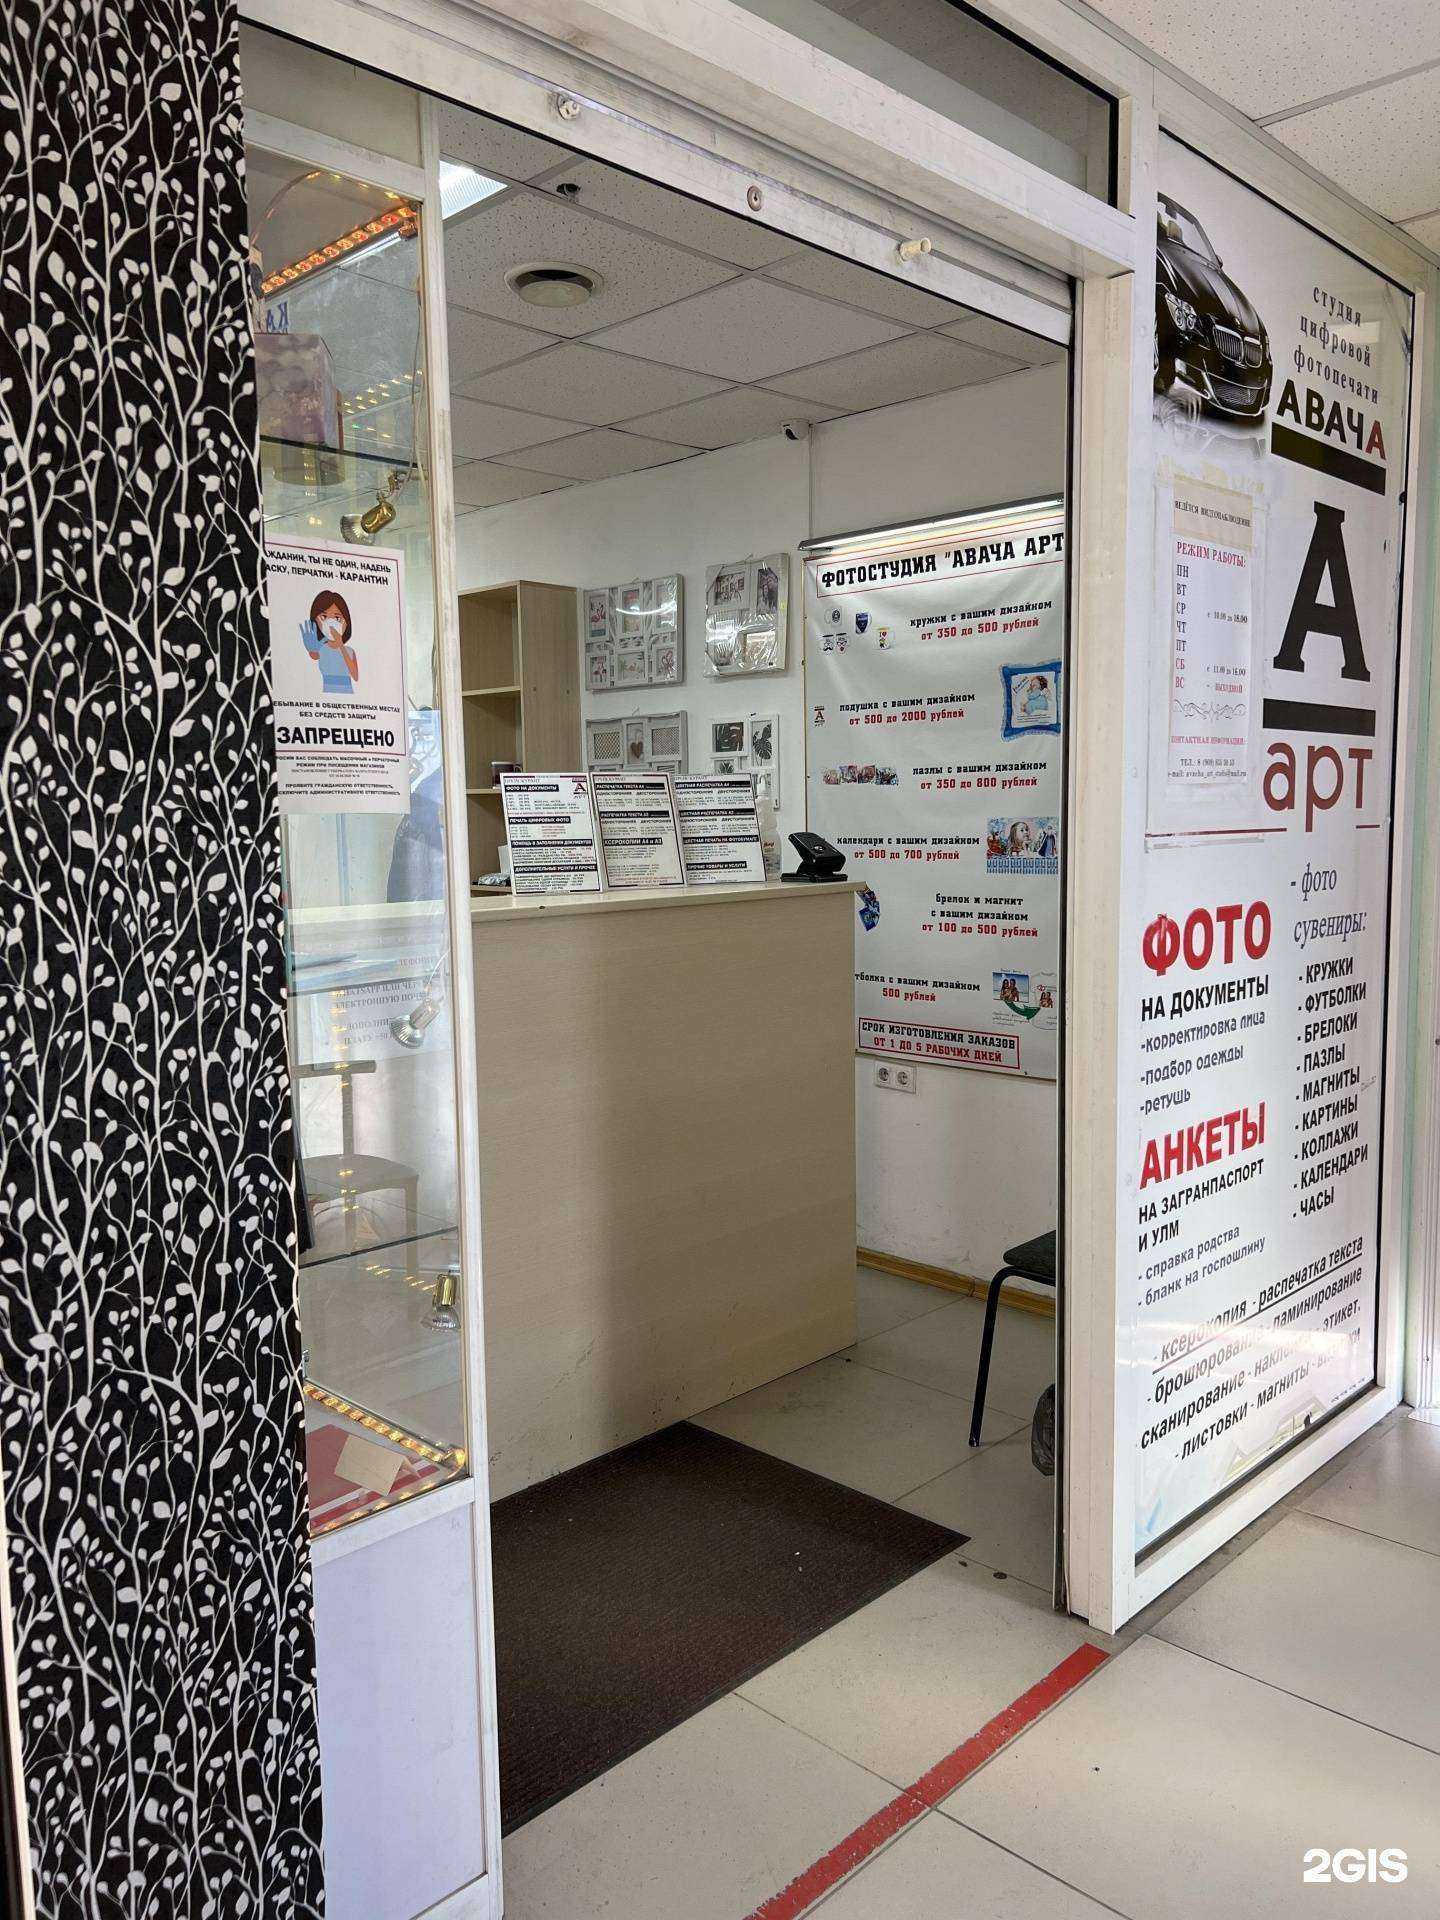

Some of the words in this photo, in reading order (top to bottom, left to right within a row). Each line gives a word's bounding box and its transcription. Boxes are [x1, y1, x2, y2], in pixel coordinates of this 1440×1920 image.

[1313, 286, 1362, 327] студия
[1300, 316, 1370, 368] цифровой
[1294, 345, 1378, 404] фотопечати
[1276, 379, 1386, 460] АВАЧА
[266, 550, 306, 563] ЖДАНИН,
[308, 556, 320, 564] ТЫ
[335, 559, 358, 569] ОДИН,
[361, 563, 391, 572] НАДЕНЬ
[821, 553, 937, 588] ФОТОСТУДИЯ
[945, 541, 1015, 569] "АВАЧА
[1024, 532, 1064, 557] АРТ
[1177, 542, 1210, 559] РЕЖИМ
[1212, 549, 1246, 568] РАБОТЫ:
[266, 564, 290, 574] АСКУ,
[292, 567, 334, 579] ПЕРЧАТКИ
[340, 572, 389, 585] КАРАНТИН
[1177, 564, 1188, 577] ПН
[1177, 583, 1187, 596] ВТ
[1273, 501, 1370, 682] А
[910, 613, 947, 628] кружки
[951, 613, 956, 622] с
[961, 608, 995, 621] вашим
[1000, 600, 1052, 616] дизайном
[1177, 602, 1185, 614] СР
[921, 631, 933, 641] от
[937, 626, 957, 639] 350
[961, 627, 973, 637] до
[977, 621, 998, 634] 500
[1002, 618, 1039, 634] рублей
[1177, 621, 1186, 633] ЧТ
[1176, 639, 1186, 651] ПТ
[1176, 658, 1185, 669] СБ
[1176, 677, 1184, 688] ВС
[322, 703, 377, 711] ОБЩЕСТВЕННЫХ
[839, 701, 879, 714] подушка
[882, 701, 888, 709] с
[892, 697, 923, 708] вашим
[927, 693, 976, 706] дизайном
[849, 716, 860, 726] от
[864, 712, 883, 724] 500
[886, 715, 897, 723] до
[901, 711, 926, 722] 2000
[931, 708, 964, 721] рублей
[277, 727, 394, 748] ЗАПРЕЩЕНО
[912, 766, 943, 776] пазлы
[957, 764, 991, 774] вашим
[995, 761, 1047, 773] дизайном
[920, 780, 932, 789] от
[937, 779, 956, 789] 350
[960, 780, 972, 789] до
[1001, 776, 1038, 789] рублей
[1263, 742, 1373, 833] арт
[837, 836, 884, 845] календари
[896, 836, 928, 845] вашим
[931, 836, 980, 845] дизайном
[854, 850, 864, 860] от
[868, 849, 886, 859] 500
[889, 851, 900, 860] до
[904, 849, 922, 860] 700
[926, 850, 960, 862] рублей
[1302, 862, 1337, 901] фото
[935, 893, 970, 906] брелок
[974, 896, 981, 905] и
[985, 896, 1023, 906] магнит
[940, 909, 974, 919] вашим
[978, 910, 1028, 921] дизайном
[922, 923, 933, 932] от
[938, 923, 957, 933] 100
[961, 925, 973, 934] до
[977, 924, 997, 935] 500
[1001, 926, 1038, 937] рублей
[1142, 900, 1271, 977] ФОТО
[1294, 912, 1367, 949] сувениры:
[855, 973, 885, 983] тболка
[889, 976, 894, 984] с
[897, 977, 929, 987] вашим
[932, 979, 980, 991] дизайном
[1306, 956, 1353, 984] КРУЖКИ
[882, 988, 900, 999] 500
[904, 991, 936, 1002] рублей
[1141, 996, 1165, 1022] НА
[1170, 974, 1269, 1021] ДОКУМЕНТЫ
[1305, 982, 1367, 1013] ФУТБОЛКИ
[1240, 1010, 1265, 1029] лица
[1305, 1012, 1358, 1043] БРЕЛОКИ
[862, 1021, 885, 1034] СРОК
[888, 1025, 964, 1043] ИЗГОТОВЛЕНИЯ
[968, 1035, 1015, 1050] ЗАКАЗОВ
[874, 1037, 885, 1048] ОТ
[890, 1039, 895, 1049] 1
[900, 1040, 912, 1051] ДО
[916, 1042, 922, 1052] 5
[926, 1043, 970, 1058] РАБОЧИХ
[974, 1049, 1002, 1062] ДНЕЙ
[1196, 1045, 1244, 1071] одежды
[1303, 1043, 1345, 1073] ПАЗЛЫ
[1302, 1066, 1360, 1102] МАГНИТЫ
[1302, 1094, 1358, 1131] КАРТИНЫ
[1139, 1101, 1265, 1190] АНКЕТЫ
[1301, 1120, 1358, 1161] КОЛЛАЖИ
[1300, 1143, 1368, 1190] КАЛЕНДАРИ
[1139, 1200, 1157, 1225] НА
[1161, 1158, 1264, 1215] ЗАГРАНПАСПОРТ
[1300, 1186, 1334, 1218] ЧАСЫ
[1139, 1234, 1148, 1253] И
[1152, 1220, 1180, 1247] УЛМ
[1146, 1247, 1194, 1280] справка
[1197, 1227, 1240, 1259] родства
[1145, 1278, 1181, 1306] бланк
[1185, 1268, 1198, 1289] на
[1202, 1236, 1265, 1278] госпошлину
[1259, 1263, 1326, 1313] распечатка
[1329, 1235, 1363, 1266] текста
[1141, 1370, 1245, 1450] сканирование
[1181, 1403, 1248, 1460] листовки
[1257, 1360, 1309, 1409] магниты
